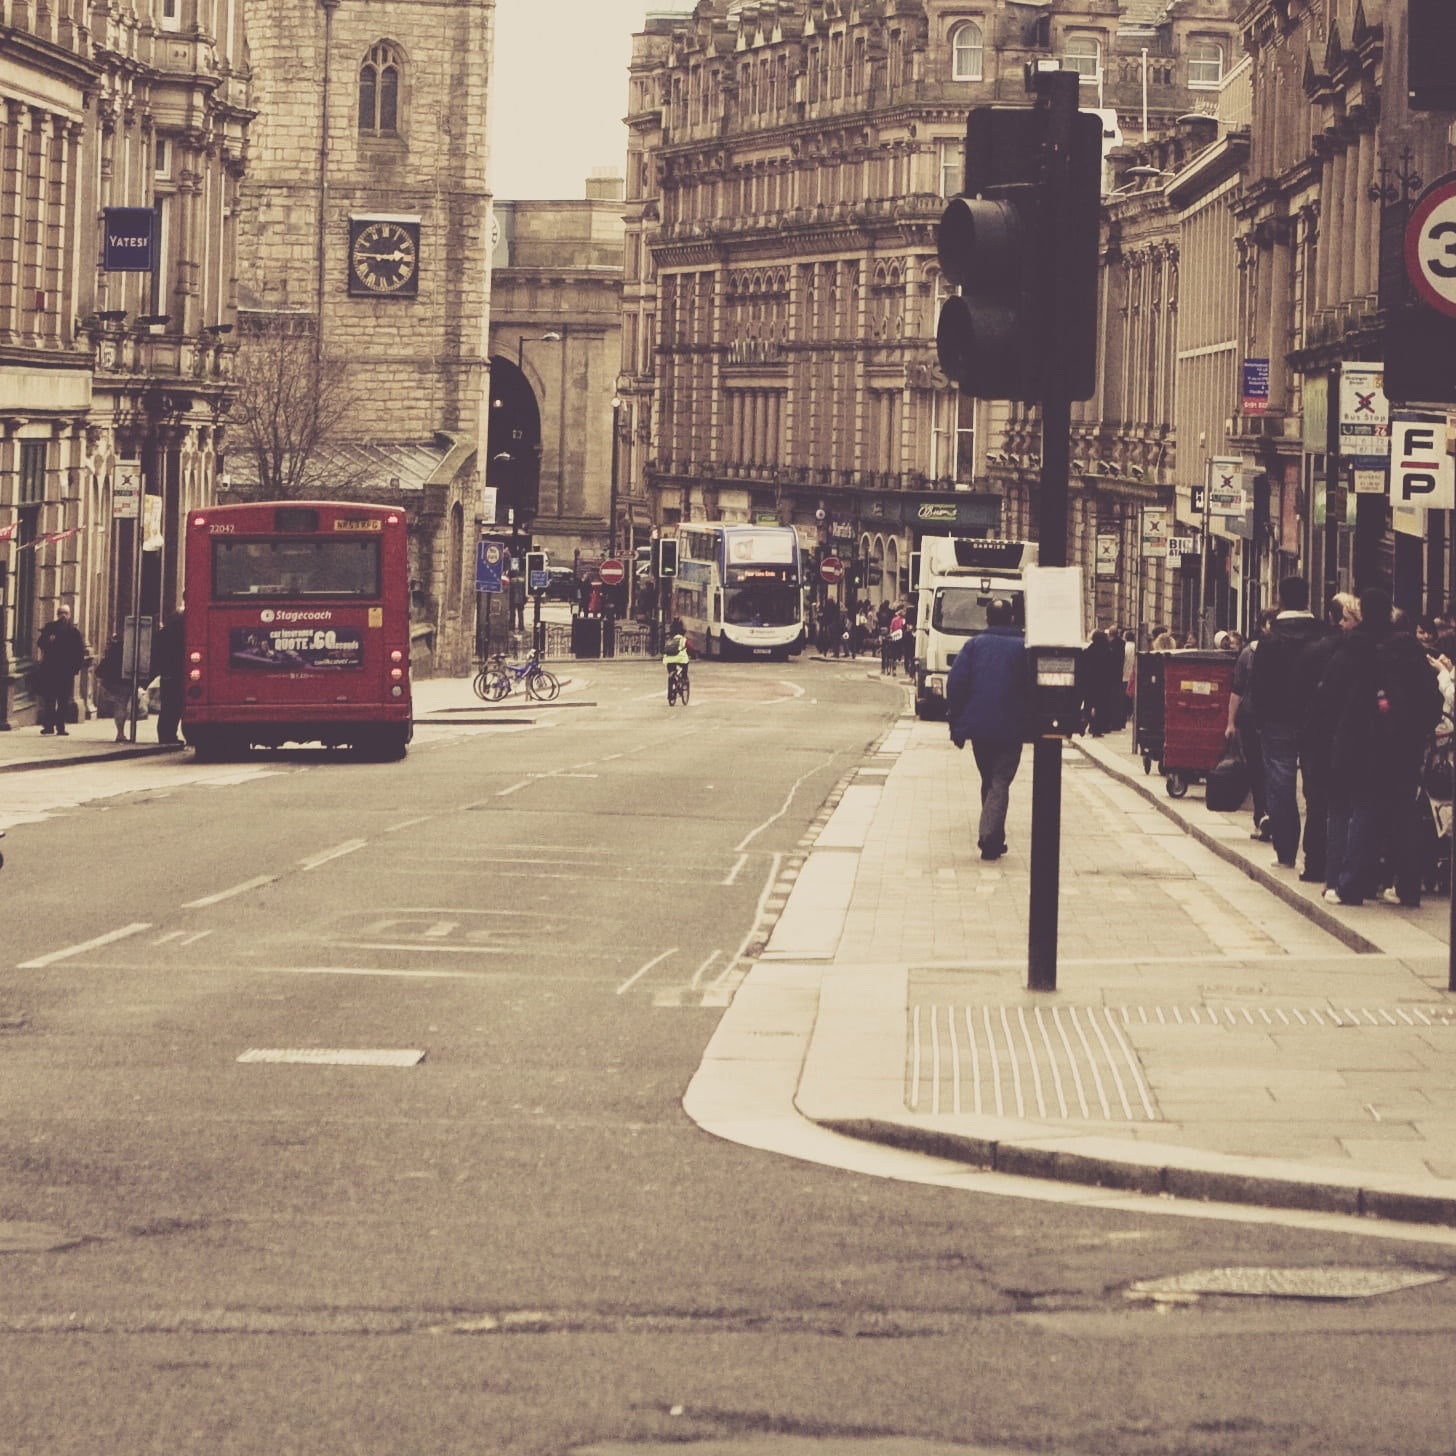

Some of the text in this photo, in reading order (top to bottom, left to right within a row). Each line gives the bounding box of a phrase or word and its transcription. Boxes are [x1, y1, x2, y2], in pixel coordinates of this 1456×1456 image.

[1364, 413, 1386, 422] Stop
[1404, 429, 1434, 456] F
[1402, 473, 1436, 501] P
[276, 610, 332, 623] Stagecoach
[274, 638, 309, 651] QUOTE
